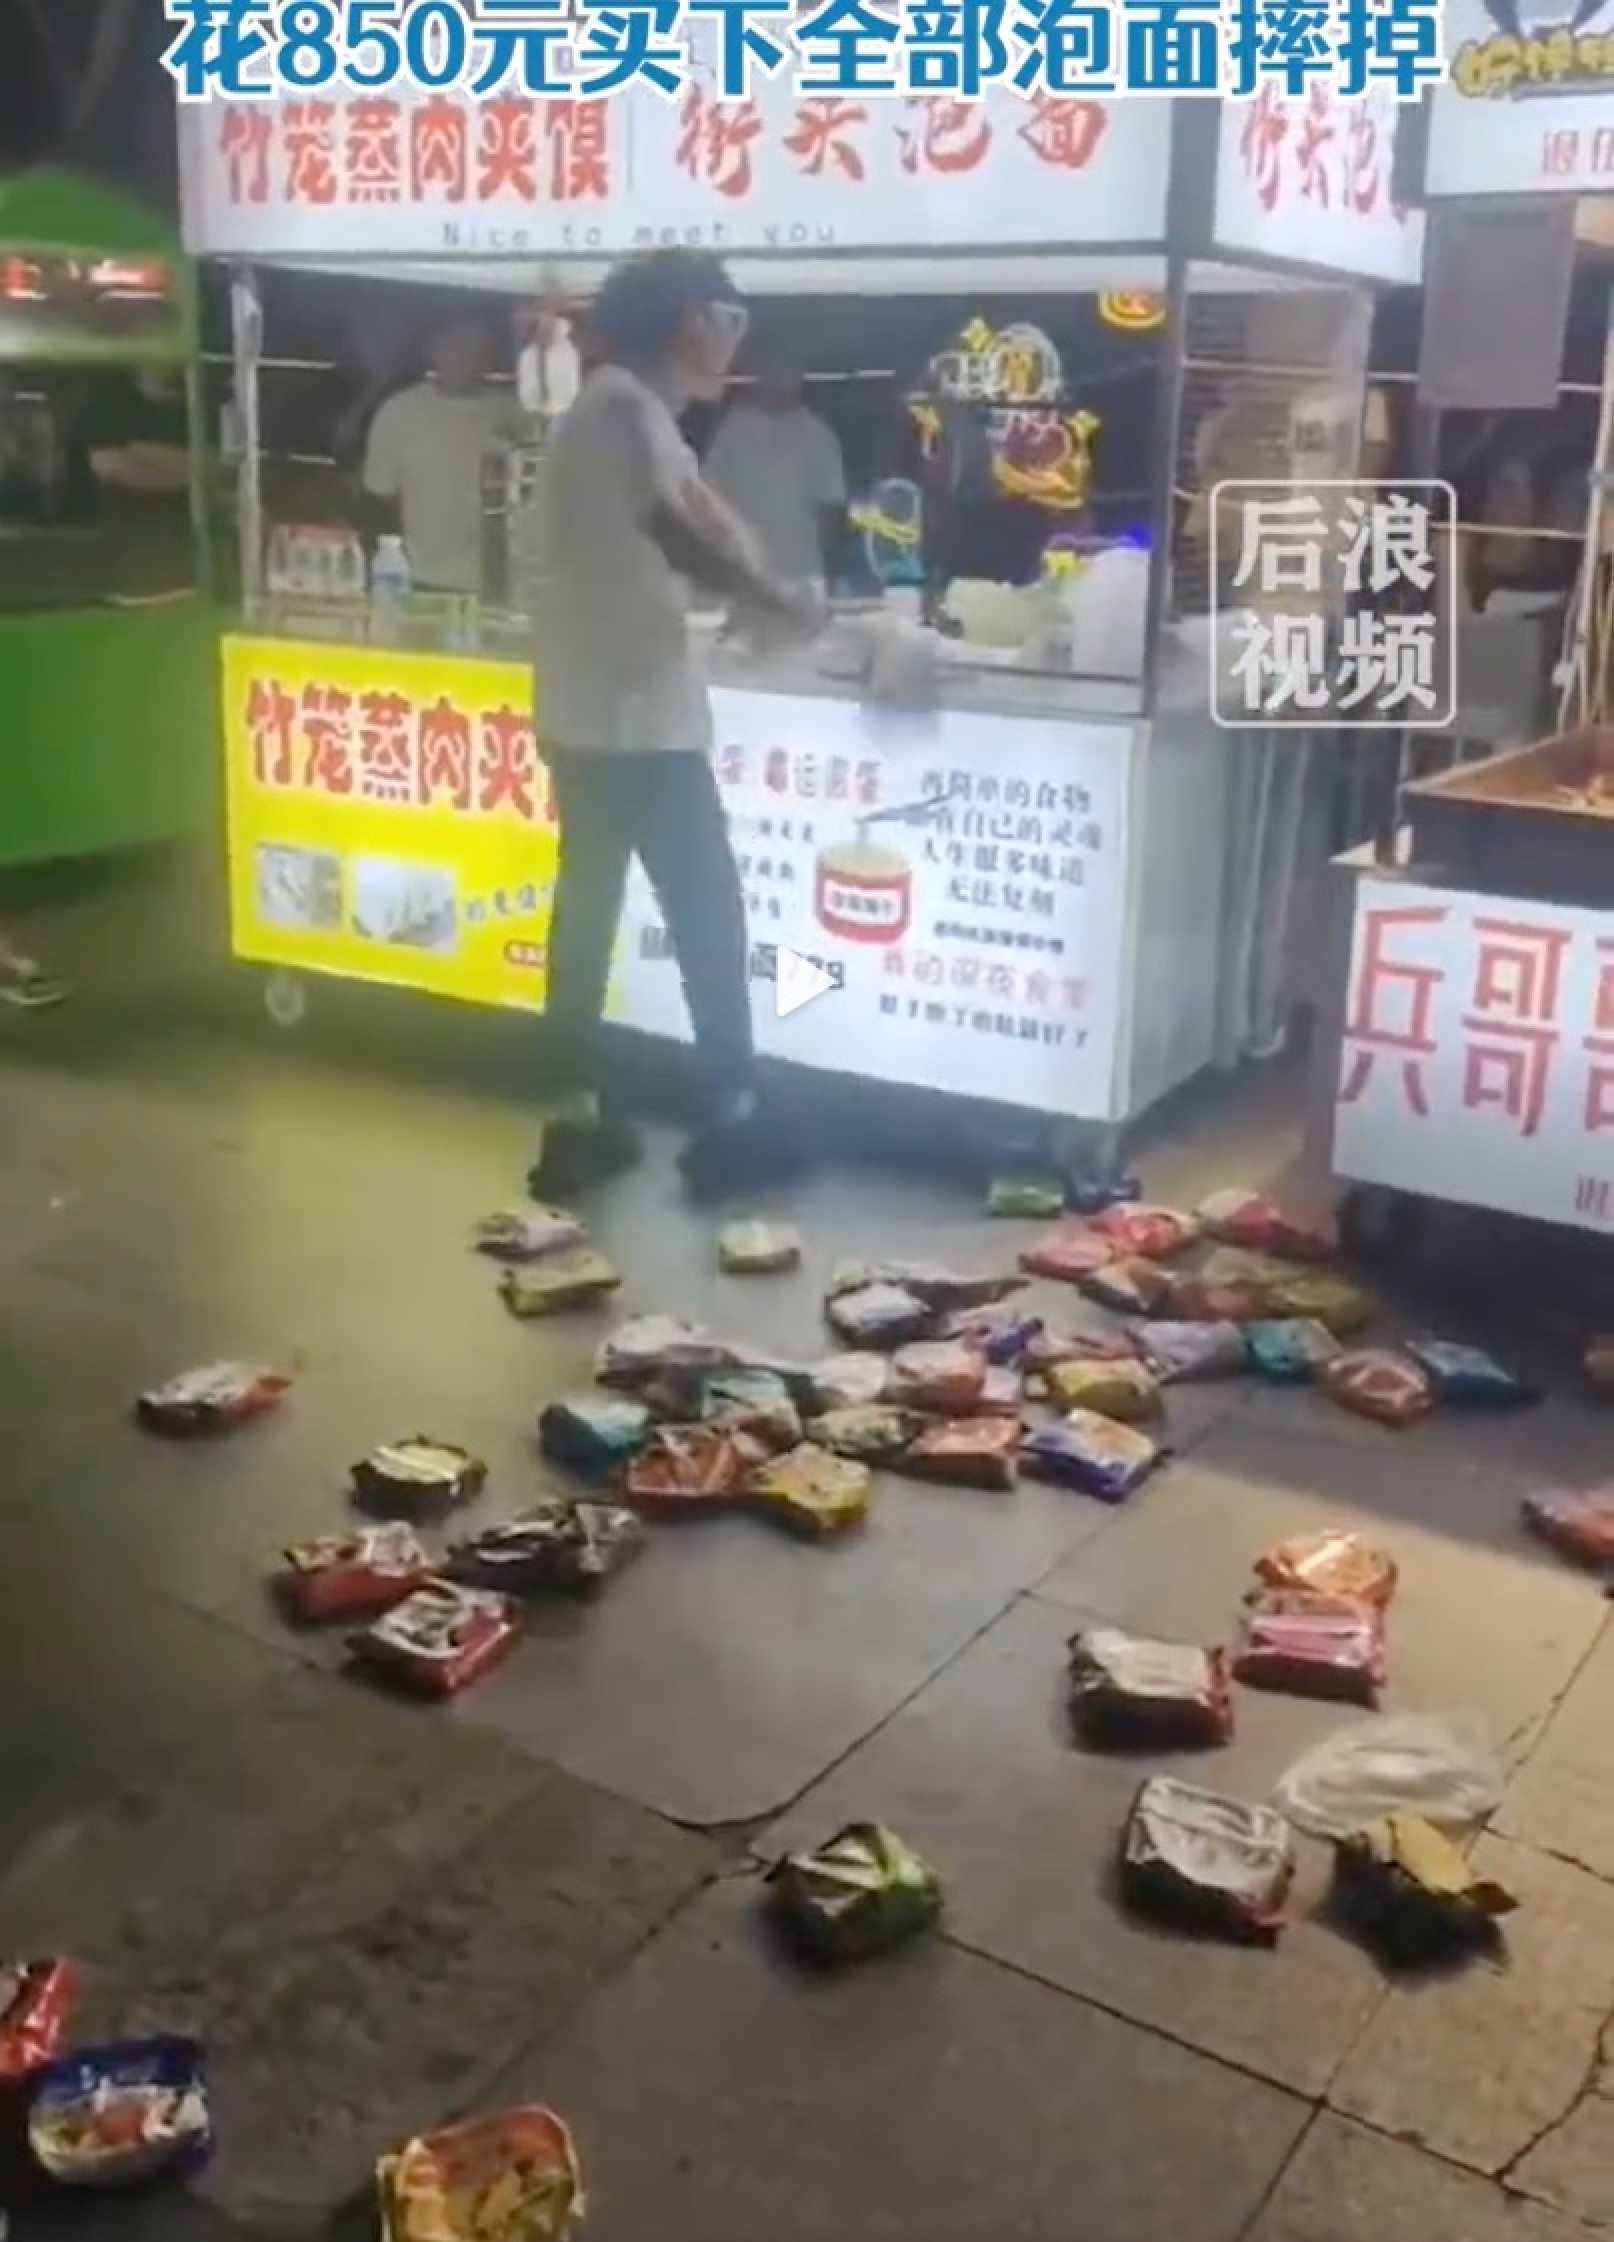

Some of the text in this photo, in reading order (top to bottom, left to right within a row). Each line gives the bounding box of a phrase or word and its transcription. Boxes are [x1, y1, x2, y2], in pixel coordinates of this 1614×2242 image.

[220, 97, 610, 204] 竹笼蒸肉夹馍
[1240, 85, 1407, 226] 街头泡
[443, 221, 836, 248] Nice to meet you
[247, 678, 558, 822] 竹笼蒸肉夹
